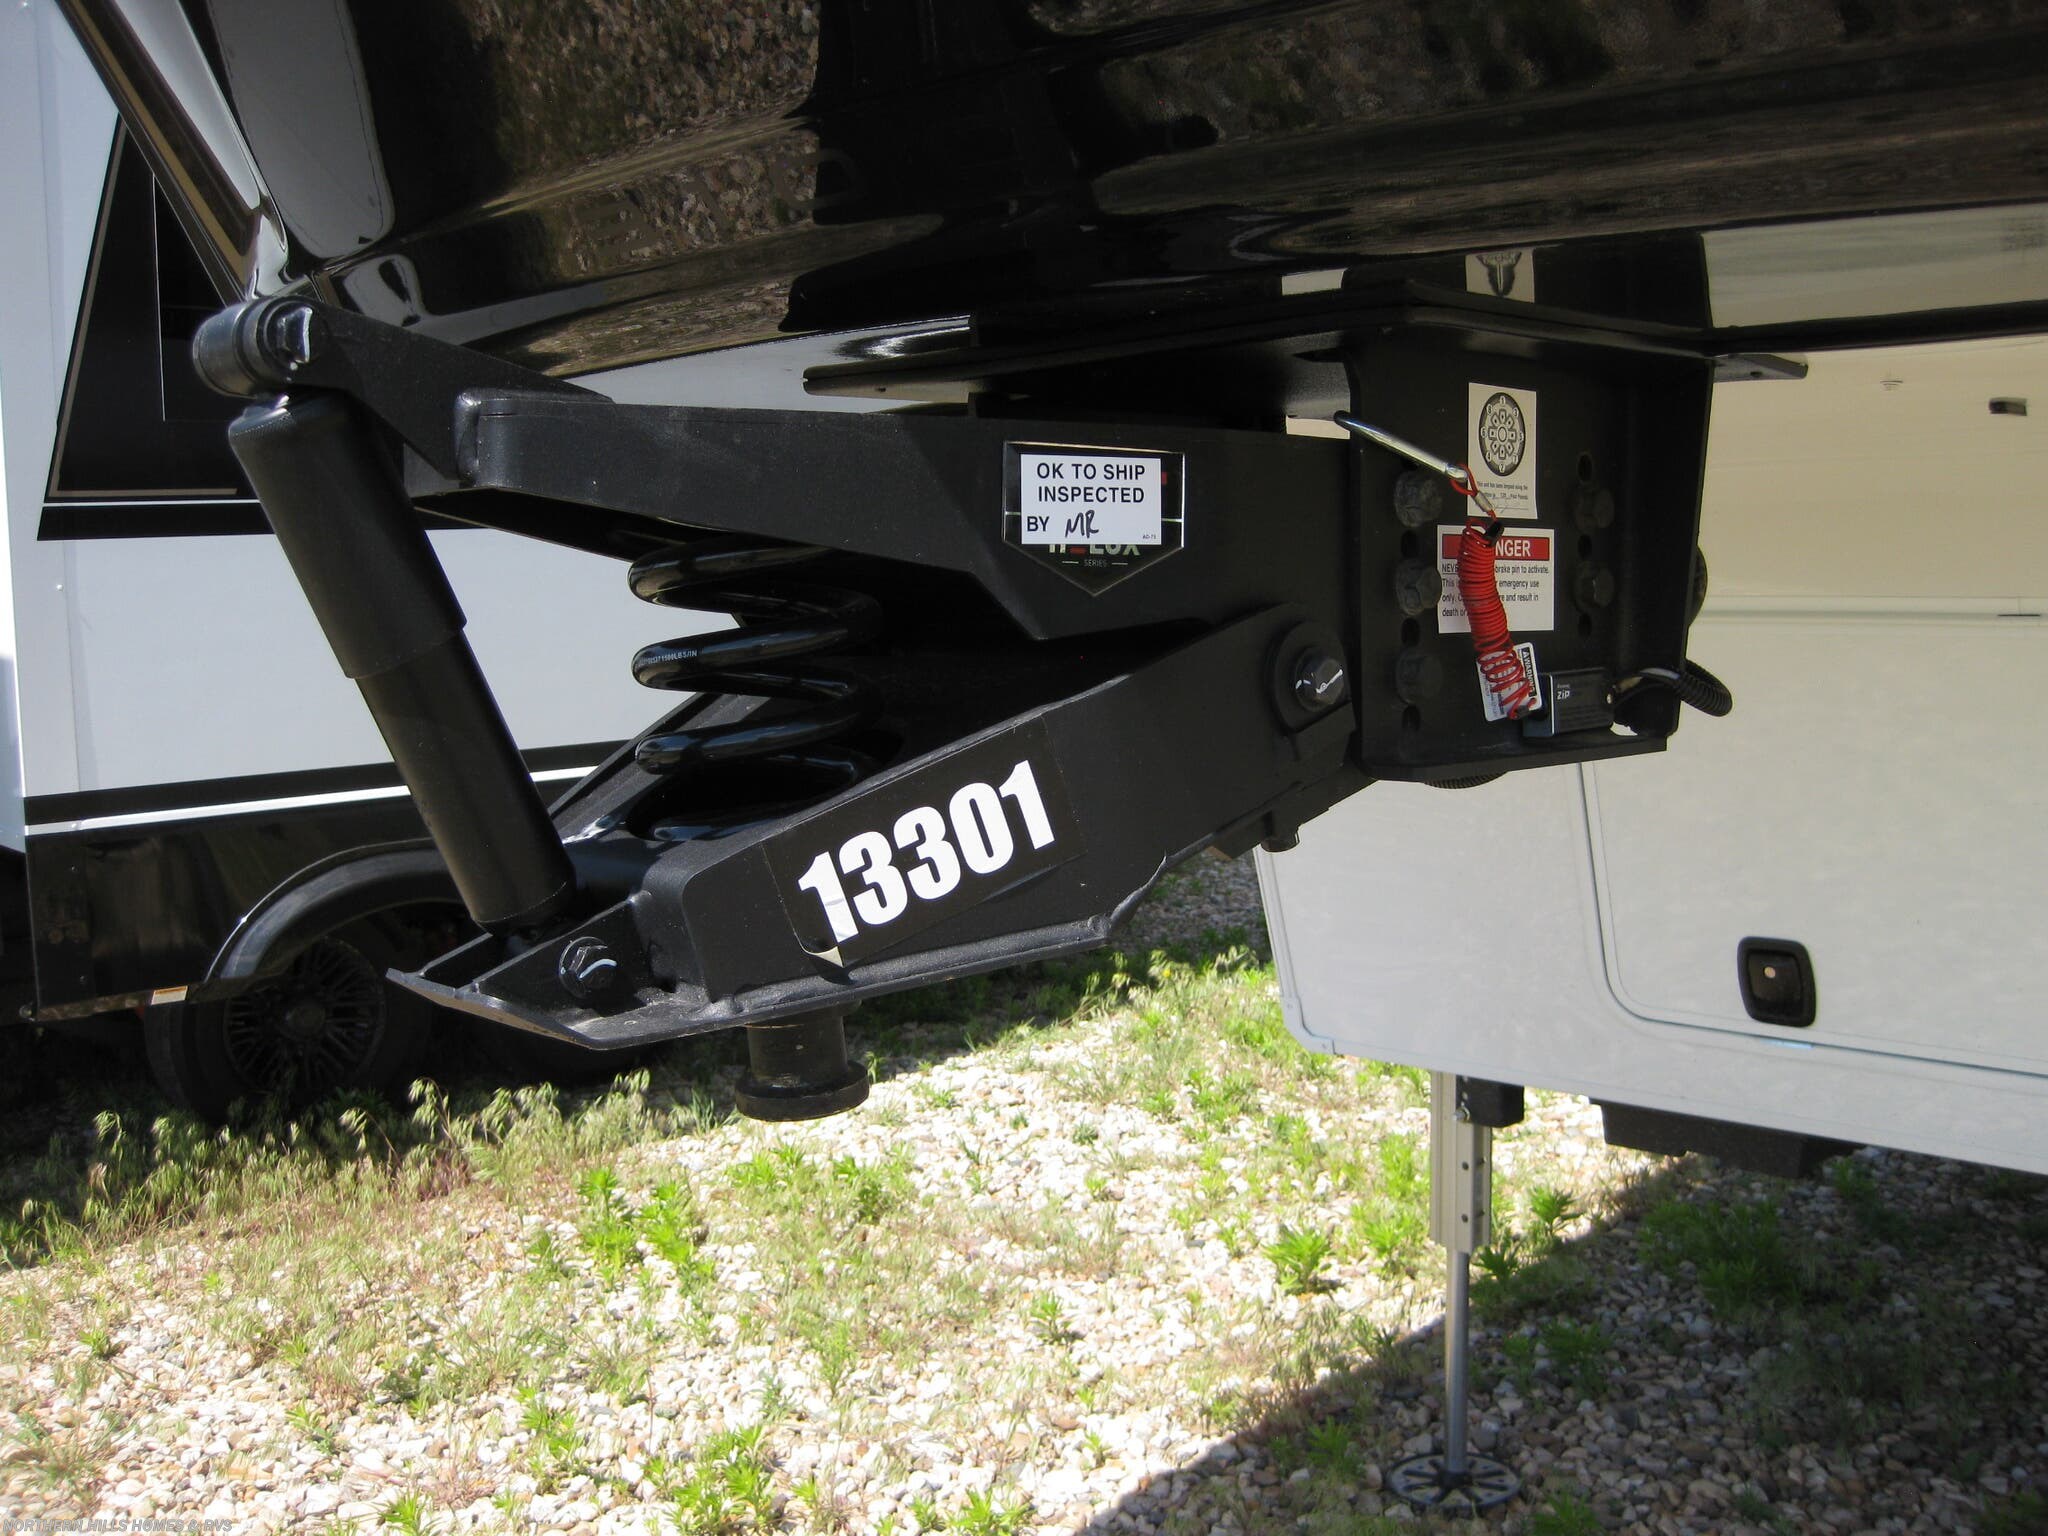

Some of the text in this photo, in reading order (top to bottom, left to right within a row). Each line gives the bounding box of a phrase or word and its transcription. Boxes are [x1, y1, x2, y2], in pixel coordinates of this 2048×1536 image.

[1036, 462, 1146, 481] OK TO SHIP
[1038, 486, 1145, 503] INSPECTED
[1026, 515, 1050, 532] BY
[1495, 539, 1531, 556] NGER
[1441, 563, 1459, 574] NEVE
[1498, 580, 1529, 590] emergency
[1529, 580, 1540, 588] use
[1505, 593, 1517, 602] and
[1517, 593, 1533, 602] result
[1441, 607, 1459, 617] death
[797, 760, 1055, 943] 13301
